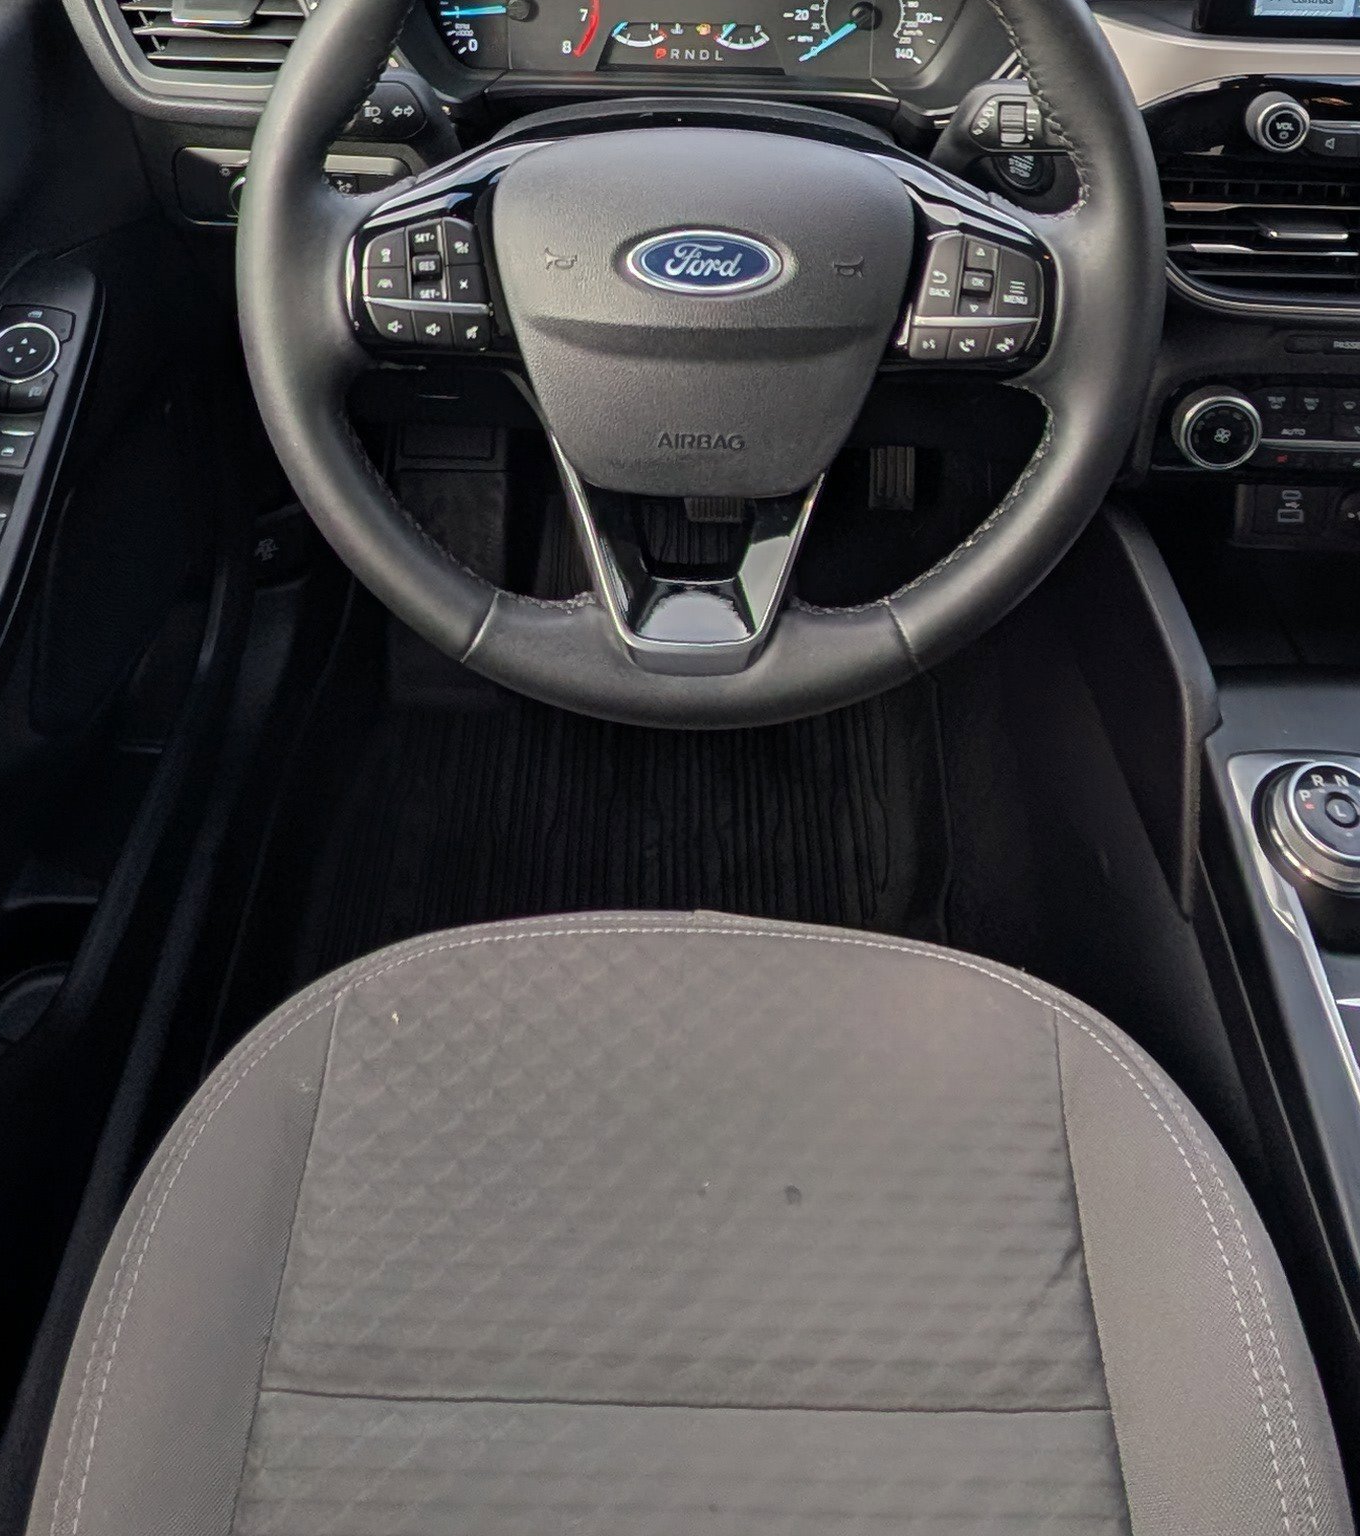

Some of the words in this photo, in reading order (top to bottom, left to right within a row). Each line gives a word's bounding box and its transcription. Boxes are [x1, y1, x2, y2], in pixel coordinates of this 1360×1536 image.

[579, 8, 588, 22] 7
[795, 9, 810, 21] 20
[916, 13, 933, 24] 120
[468, 39, 478, 52] 0
[562, 40, 572, 54] 8
[655, 48, 667, 59] P
[671, 50, 680, 59] R
[685, 50, 695, 60] N
[700, 50, 710, 60] D
[715, 50, 724, 61] L
[895, 48, 914, 59] 140
[1276, 122, 1294, 131] VOL
[419, 261, 436, 271] RES
[665, 243, 743, 277] Ford
[971, 277, 984, 287] OK
[929, 287, 951, 298] BACK
[1003, 294, 1028, 305] MENU
[1281, 428, 1306, 436] AUTO
[658, 432, 746, 451] AIRBAG
[1311, 774, 1326, 787] R
[1333, 774, 1349, 787] N
[1299, 789, 1311, 802] P
[1334, 805, 1347, 818] L
